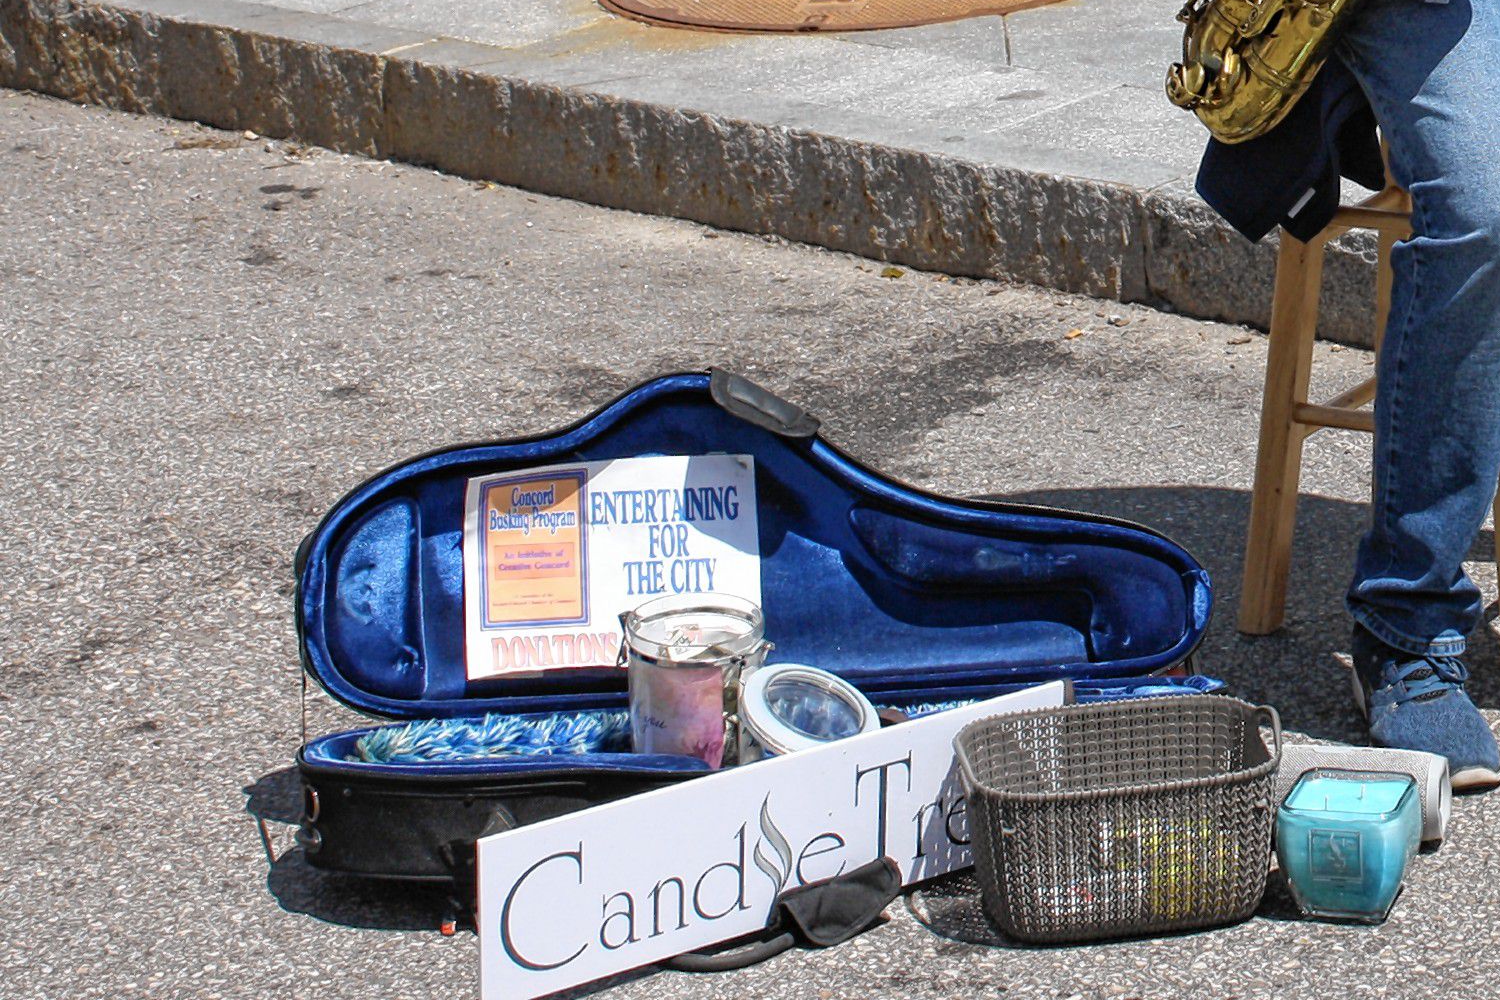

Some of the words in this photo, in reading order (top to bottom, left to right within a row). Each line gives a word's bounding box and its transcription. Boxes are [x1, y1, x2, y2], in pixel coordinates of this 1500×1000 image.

[511, 484, 554, 507] Concord
[590, 485, 740, 525] ENTERTAINING
[489, 508, 530, 535] Busking
[532, 506, 576, 534] Program
[648, 523, 690, 559] FOR
[622, 560, 666, 595] THE
[670, 558, 717, 594] CITY
[491, 632, 618, 671] DONATIONS
